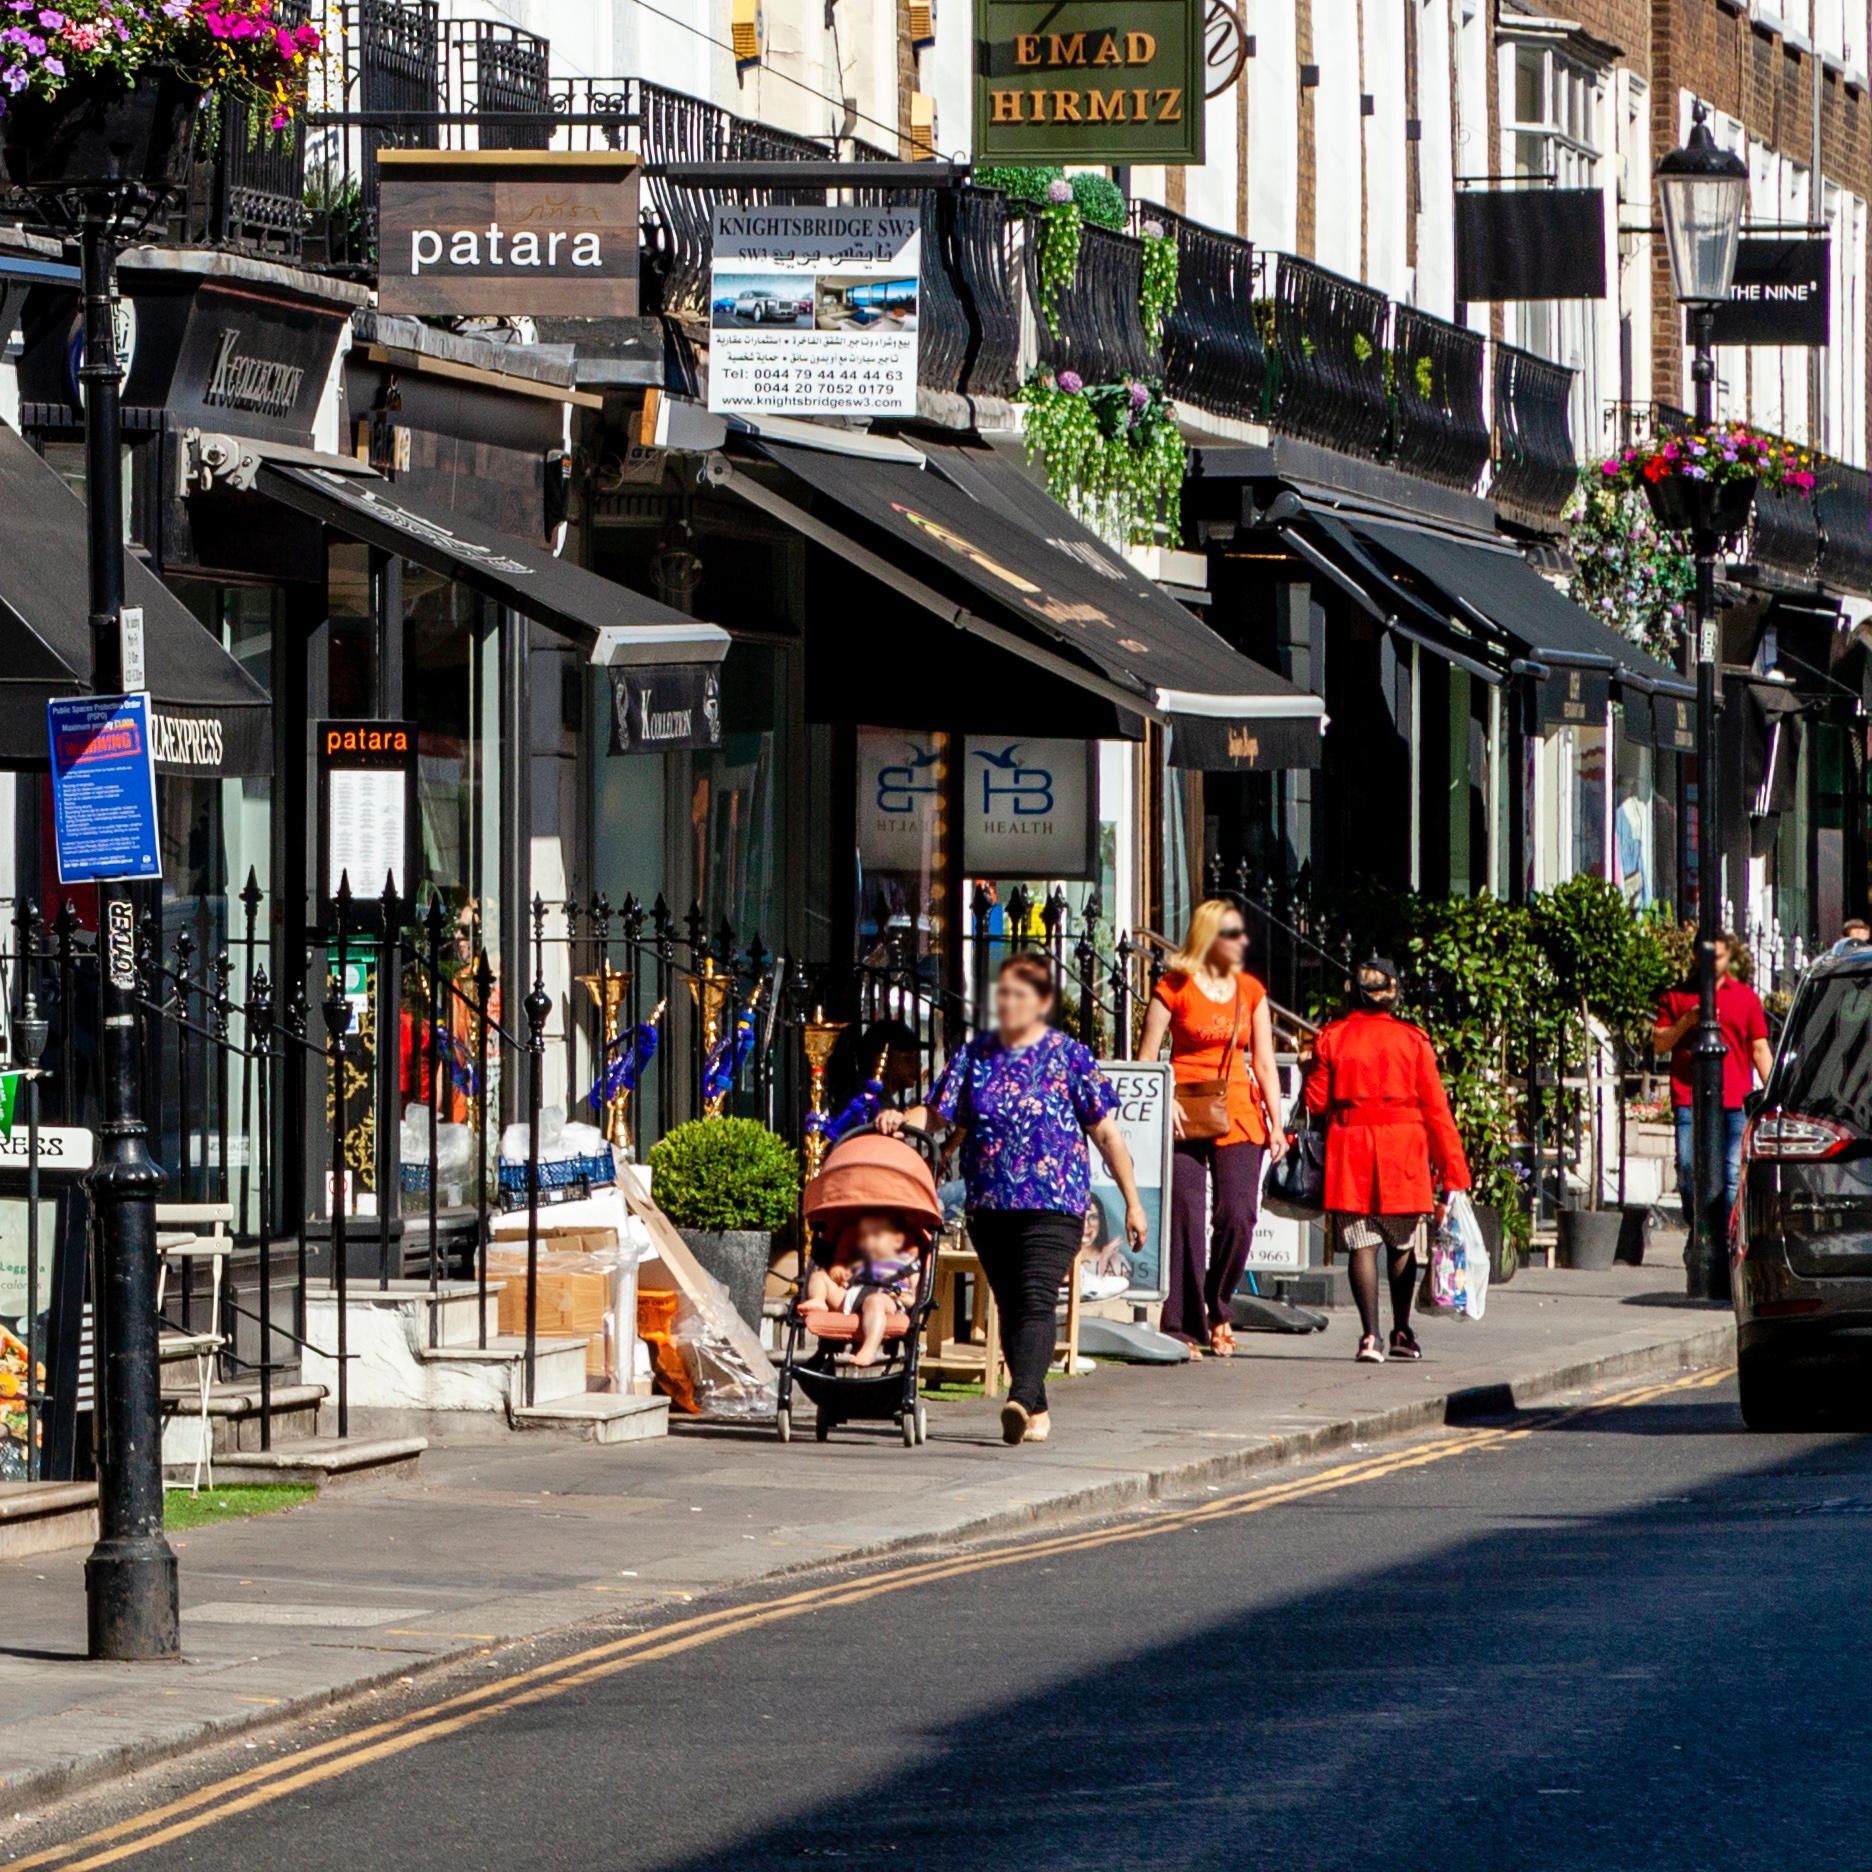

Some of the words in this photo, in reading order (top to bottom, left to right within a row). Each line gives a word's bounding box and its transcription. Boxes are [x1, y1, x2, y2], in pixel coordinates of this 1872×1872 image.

[1015, 31, 1157, 69] EMAD
[991, 88, 1182, 123] HIRMIZ
[719, 218, 873, 237] KNIGHTSBRIDGE
[878, 219, 914, 238] SW3
[411, 223, 603, 274] patara
[1729, 284, 1760, 301] THE
[721, 368, 748, 379] Tel:
[754, 368, 789, 379] 0044
[795, 369, 812, 380] 79
[817, 369, 835, 380] 44
[840, 369, 857, 380] 44
[863, 369, 880, 380] 44
[886, 370, 903, 381] 63
[754, 383, 789, 393] 0044
[795, 383, 812, 393] 20
[818, 383, 853, 394] 7052
[858, 384, 894, 394] 0179
[722, 396, 902, 409] www.knightsbridgesw3.com
[326, 728, 407, 755] patara
[984, 821, 1053, 834] HEALTH
[1258, 1249, 1290, 1263] 9663
